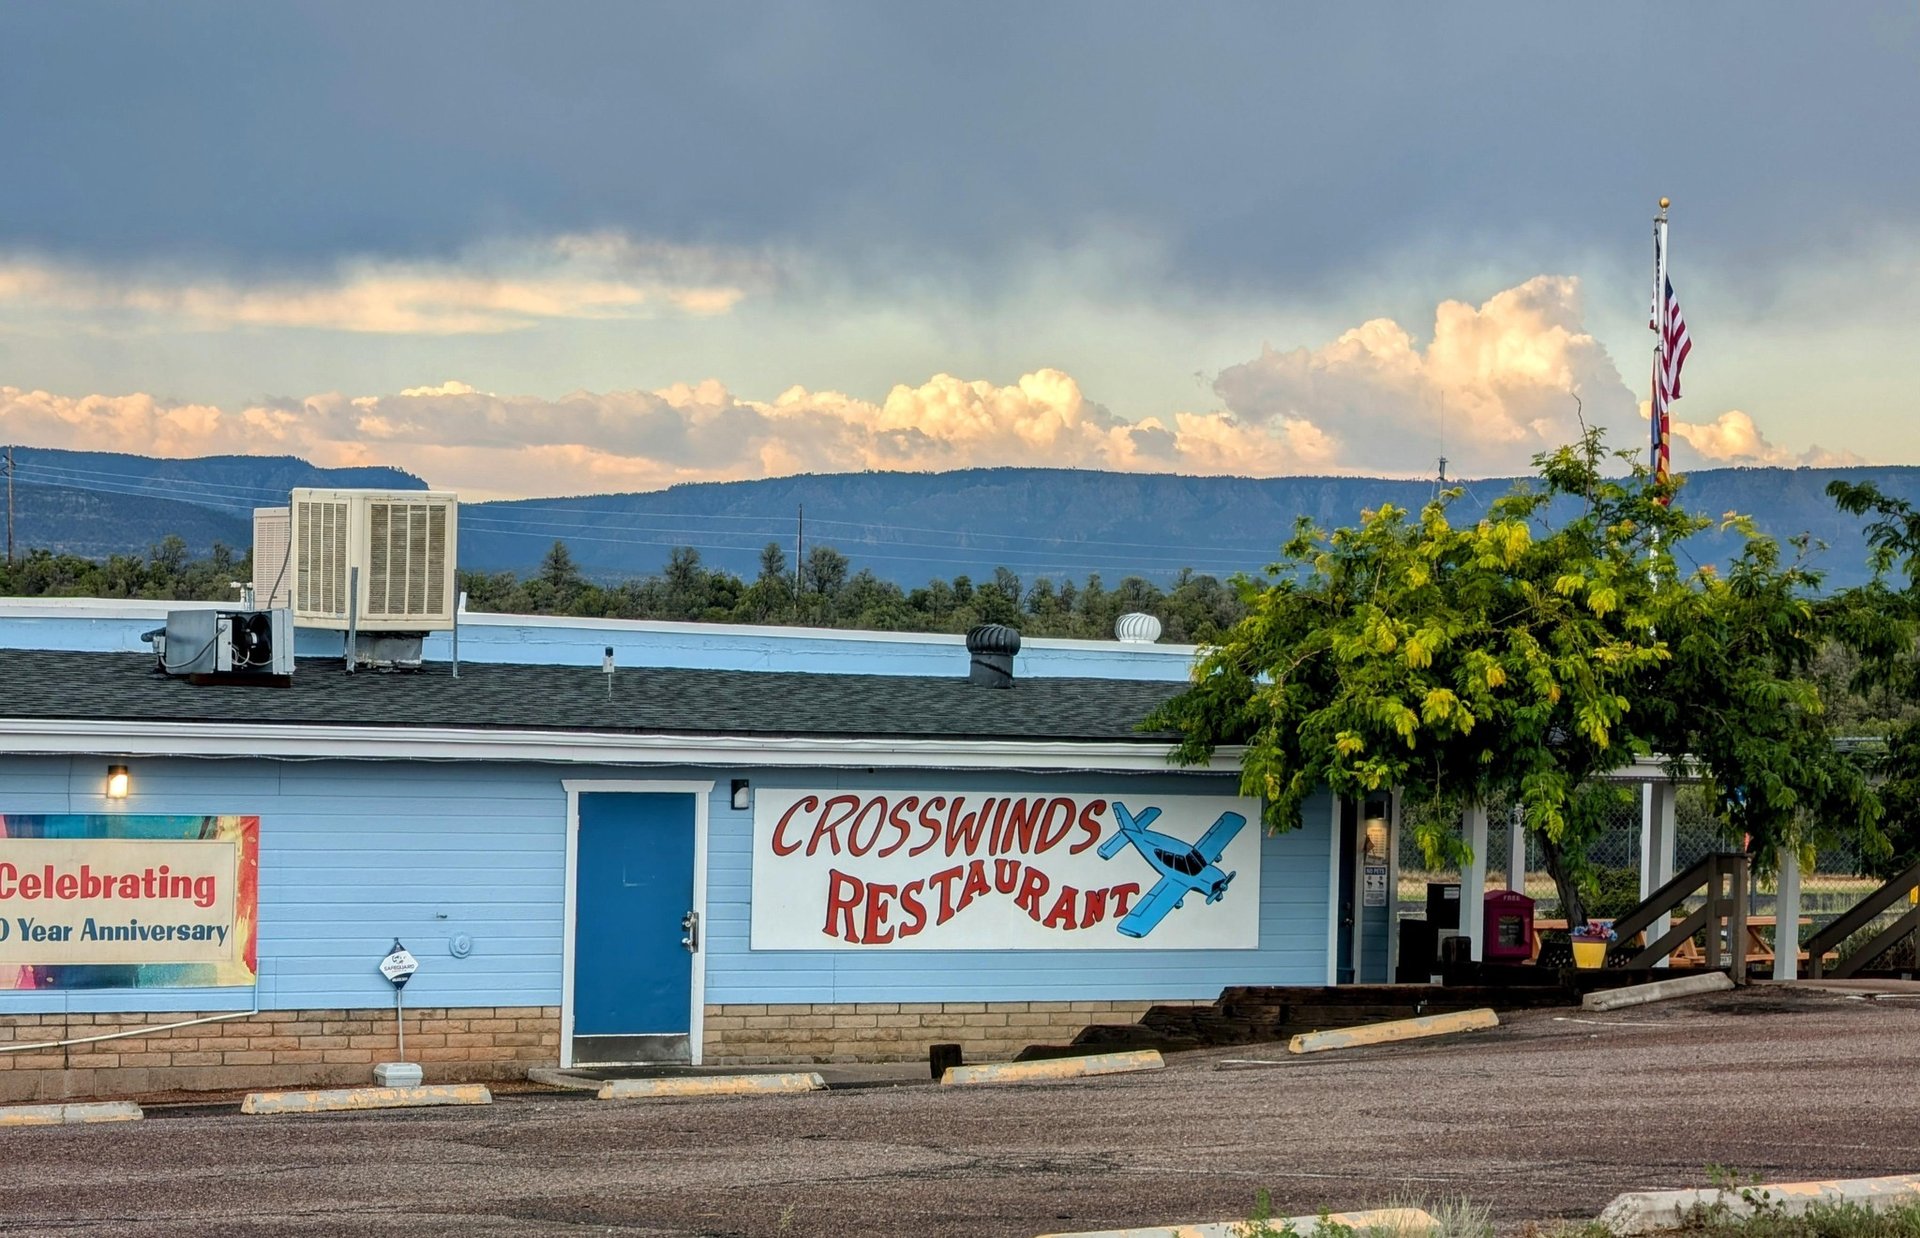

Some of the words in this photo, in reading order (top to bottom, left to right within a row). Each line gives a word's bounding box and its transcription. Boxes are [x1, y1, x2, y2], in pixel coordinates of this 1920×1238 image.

[771, 794, 1107, 858] CROSSWINDS
[0, 862, 216, 908] Celebrating
[822, 857, 1141, 945] RESTAURANT
[17, 917, 73, 942] Year
[80, 917, 229, 947] Anniversary
